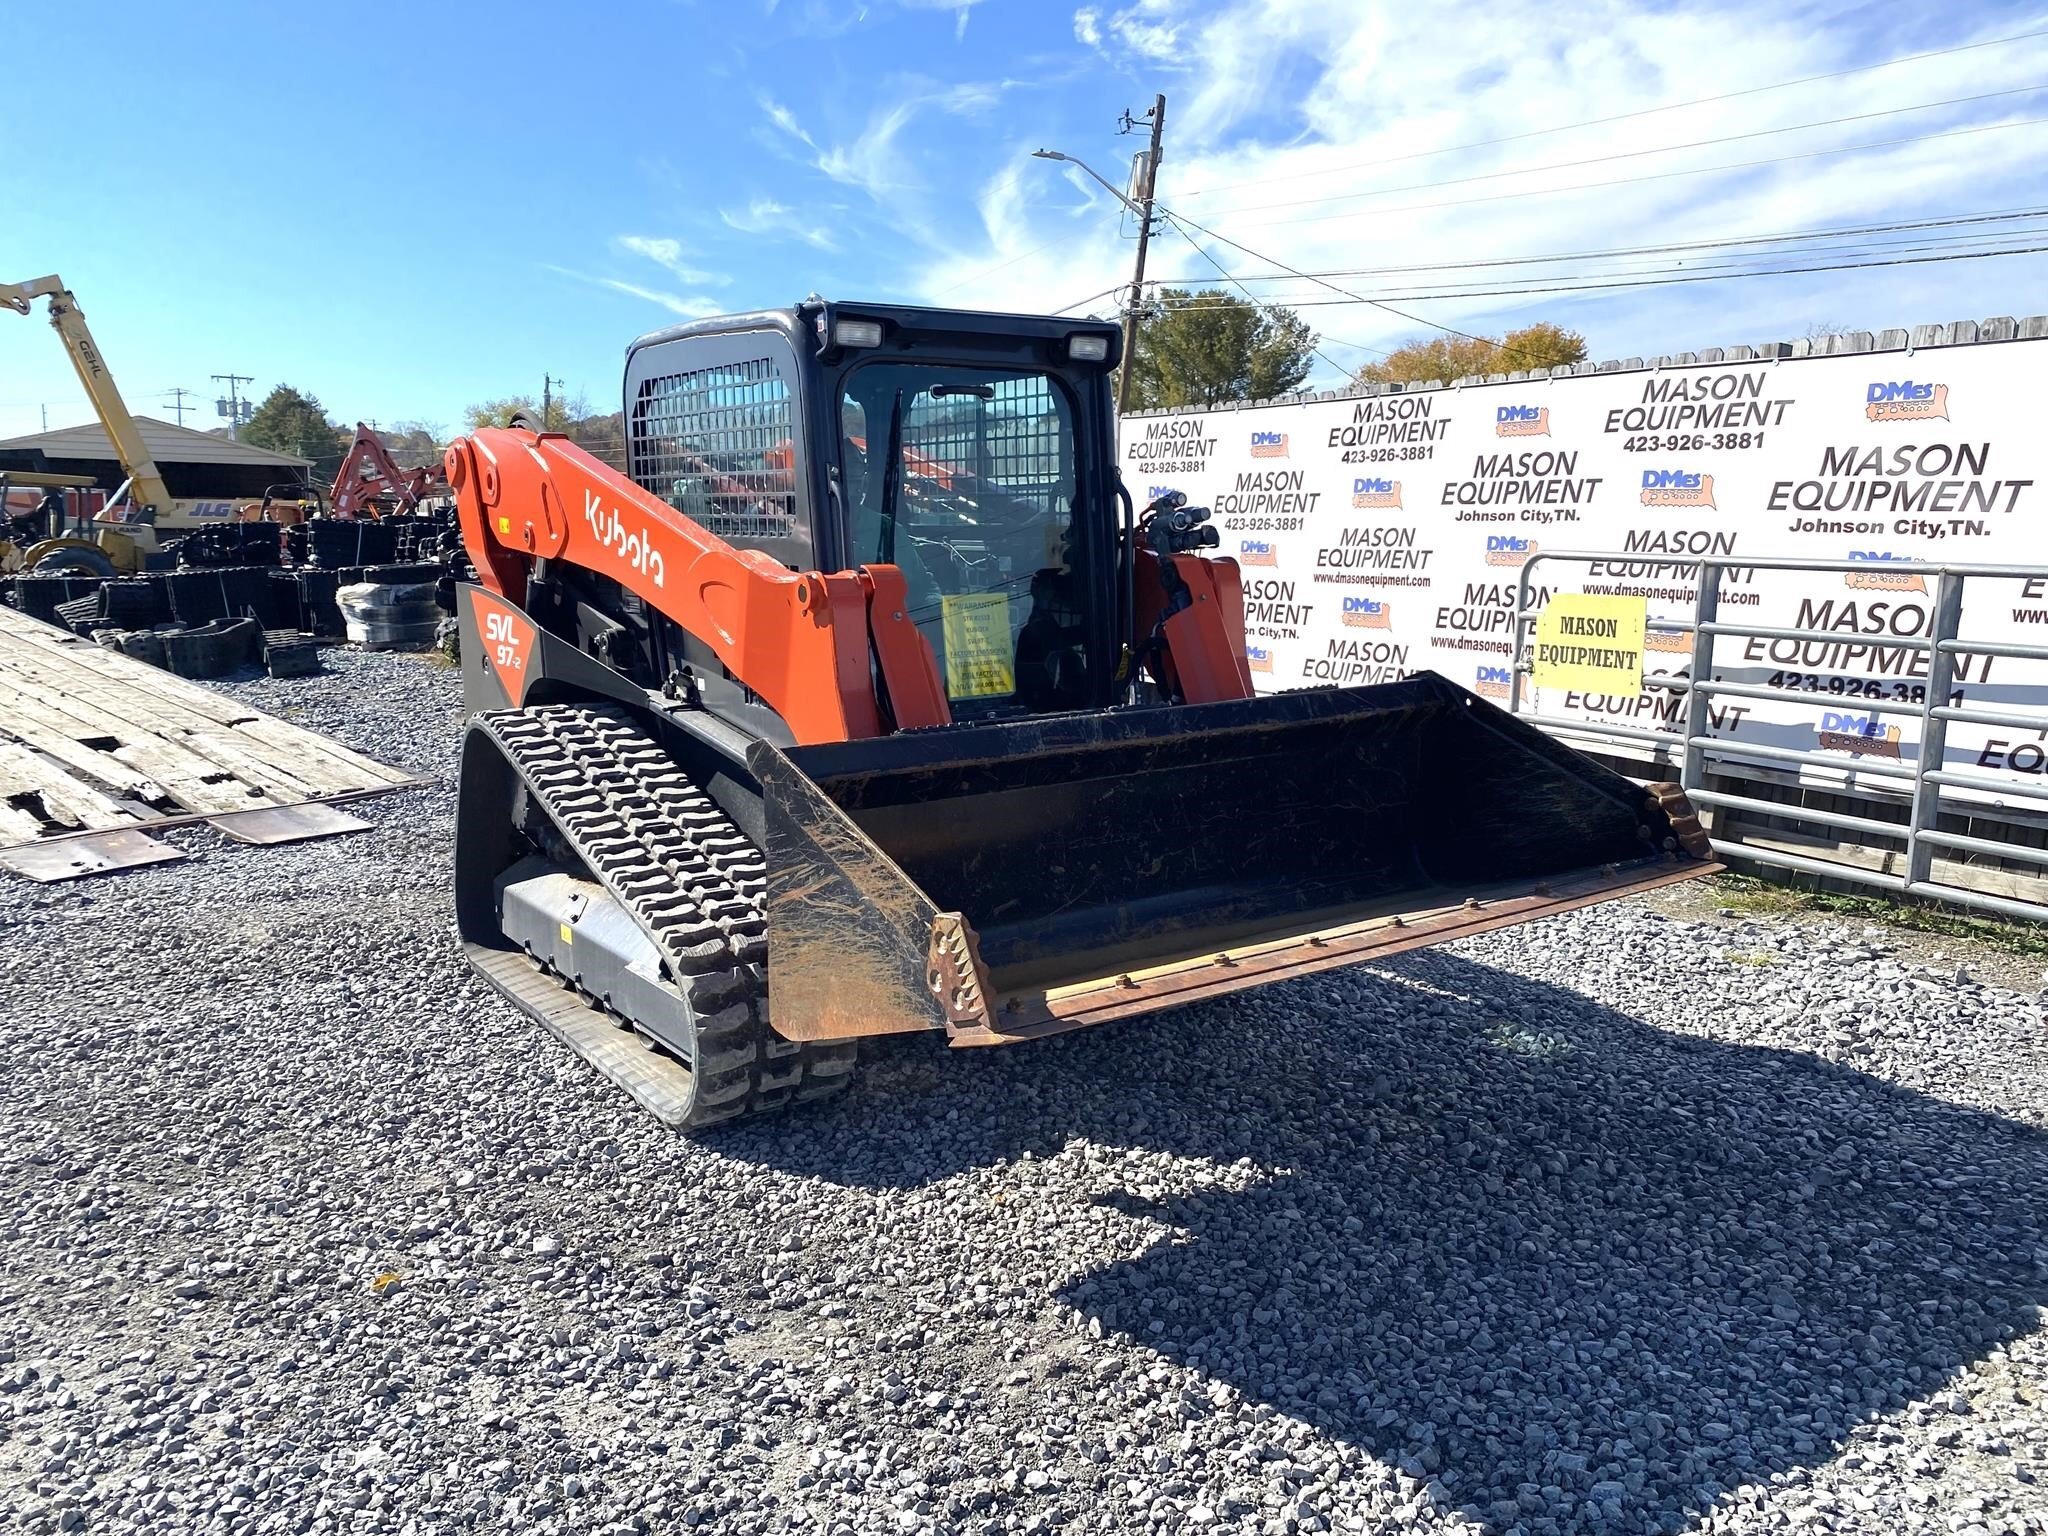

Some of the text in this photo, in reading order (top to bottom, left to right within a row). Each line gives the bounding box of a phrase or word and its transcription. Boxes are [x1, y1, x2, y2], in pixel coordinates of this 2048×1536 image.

[79, 340, 102, 379] GEHL
[1642, 372, 1767, 404] MASON
[1353, 396, 1432, 424] MASON
[1604, 400, 1796, 434] EQUIPMENT
[1145, 419, 1204, 441] MASON
[1328, 418, 1452, 448] EQUIPMENT
[1128, 438, 1218, 460] EQUIPMENT
[1623, 432, 1765, 453] 423-926-3881
[1341, 445, 1434, 464] 423-926-3881
[1473, 450, 1579, 479] MASON
[1819, 442, 1990, 478] MASON
[1138, 460, 1206, 474] 423-926-3881
[1234, 470, 1305, 492] MASON
[1440, 477, 1603, 505] EQUIPMENT
[1213, 492, 1321, 514] EQUIPMENT
[1766, 480, 2034, 514] EQUIPMENT
[188, 502, 232, 517] JLG
[1455, 509, 1516, 523] Johnson
[1224, 517, 1305, 532] 423-926-3881
[1788, 518, 1885, 535] Johnson
[584, 488, 665, 589] Kubota
[1339, 527, 1416, 548] MASON
[1623, 529, 1738, 556] MASON
[1316, 548, 1434, 571] EQUIPMENT
[1242, 579, 1296, 602] ASON
[1313, 570, 1431, 588] www.dmasonequipment.com
[486, 612, 520, 646] SVL
[1559, 616, 1619, 639] MASON
[497, 644, 521, 670] 97-2
[1327, 638, 1409, 665] MASON
[1537, 643, 1638, 671] EQUIPMENT
